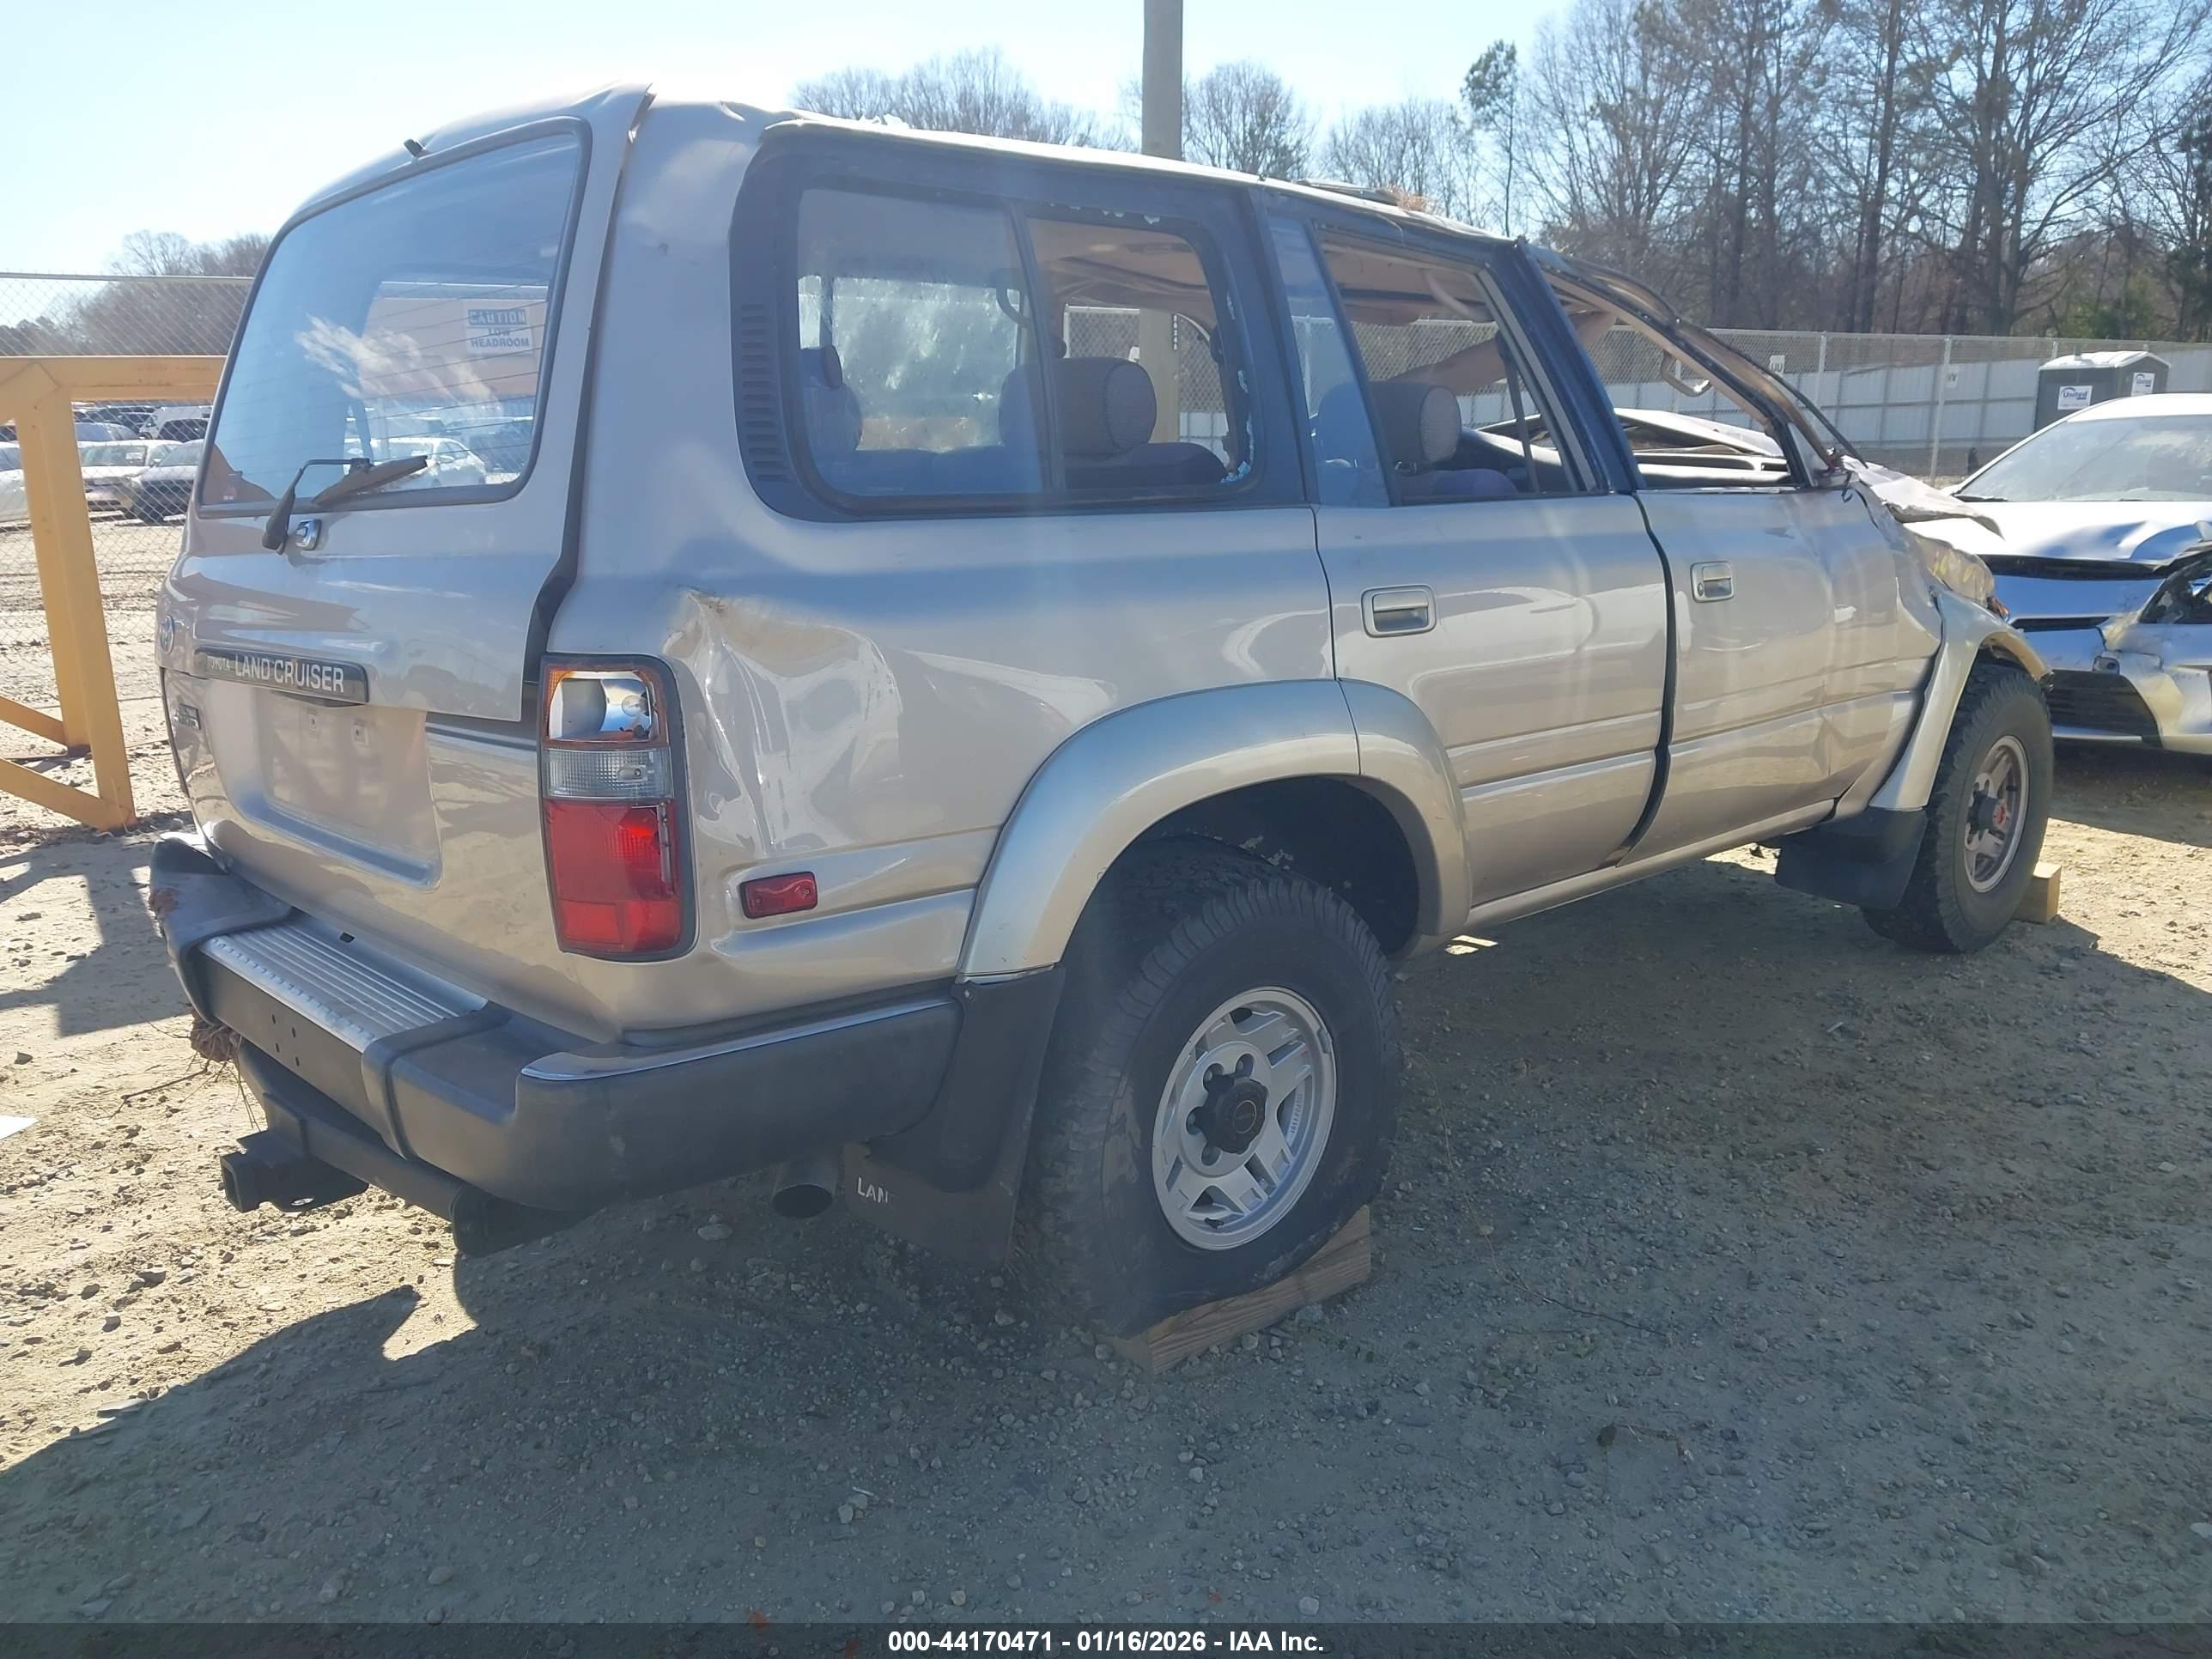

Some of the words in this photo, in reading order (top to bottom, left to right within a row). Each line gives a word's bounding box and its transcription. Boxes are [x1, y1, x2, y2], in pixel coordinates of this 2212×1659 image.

[469, 310, 526, 324] CAUTION
[471, 337, 530, 348] HEADROOM
[235, 653, 270, 681] LAND
[274, 659, 344, 694] CRUISER
